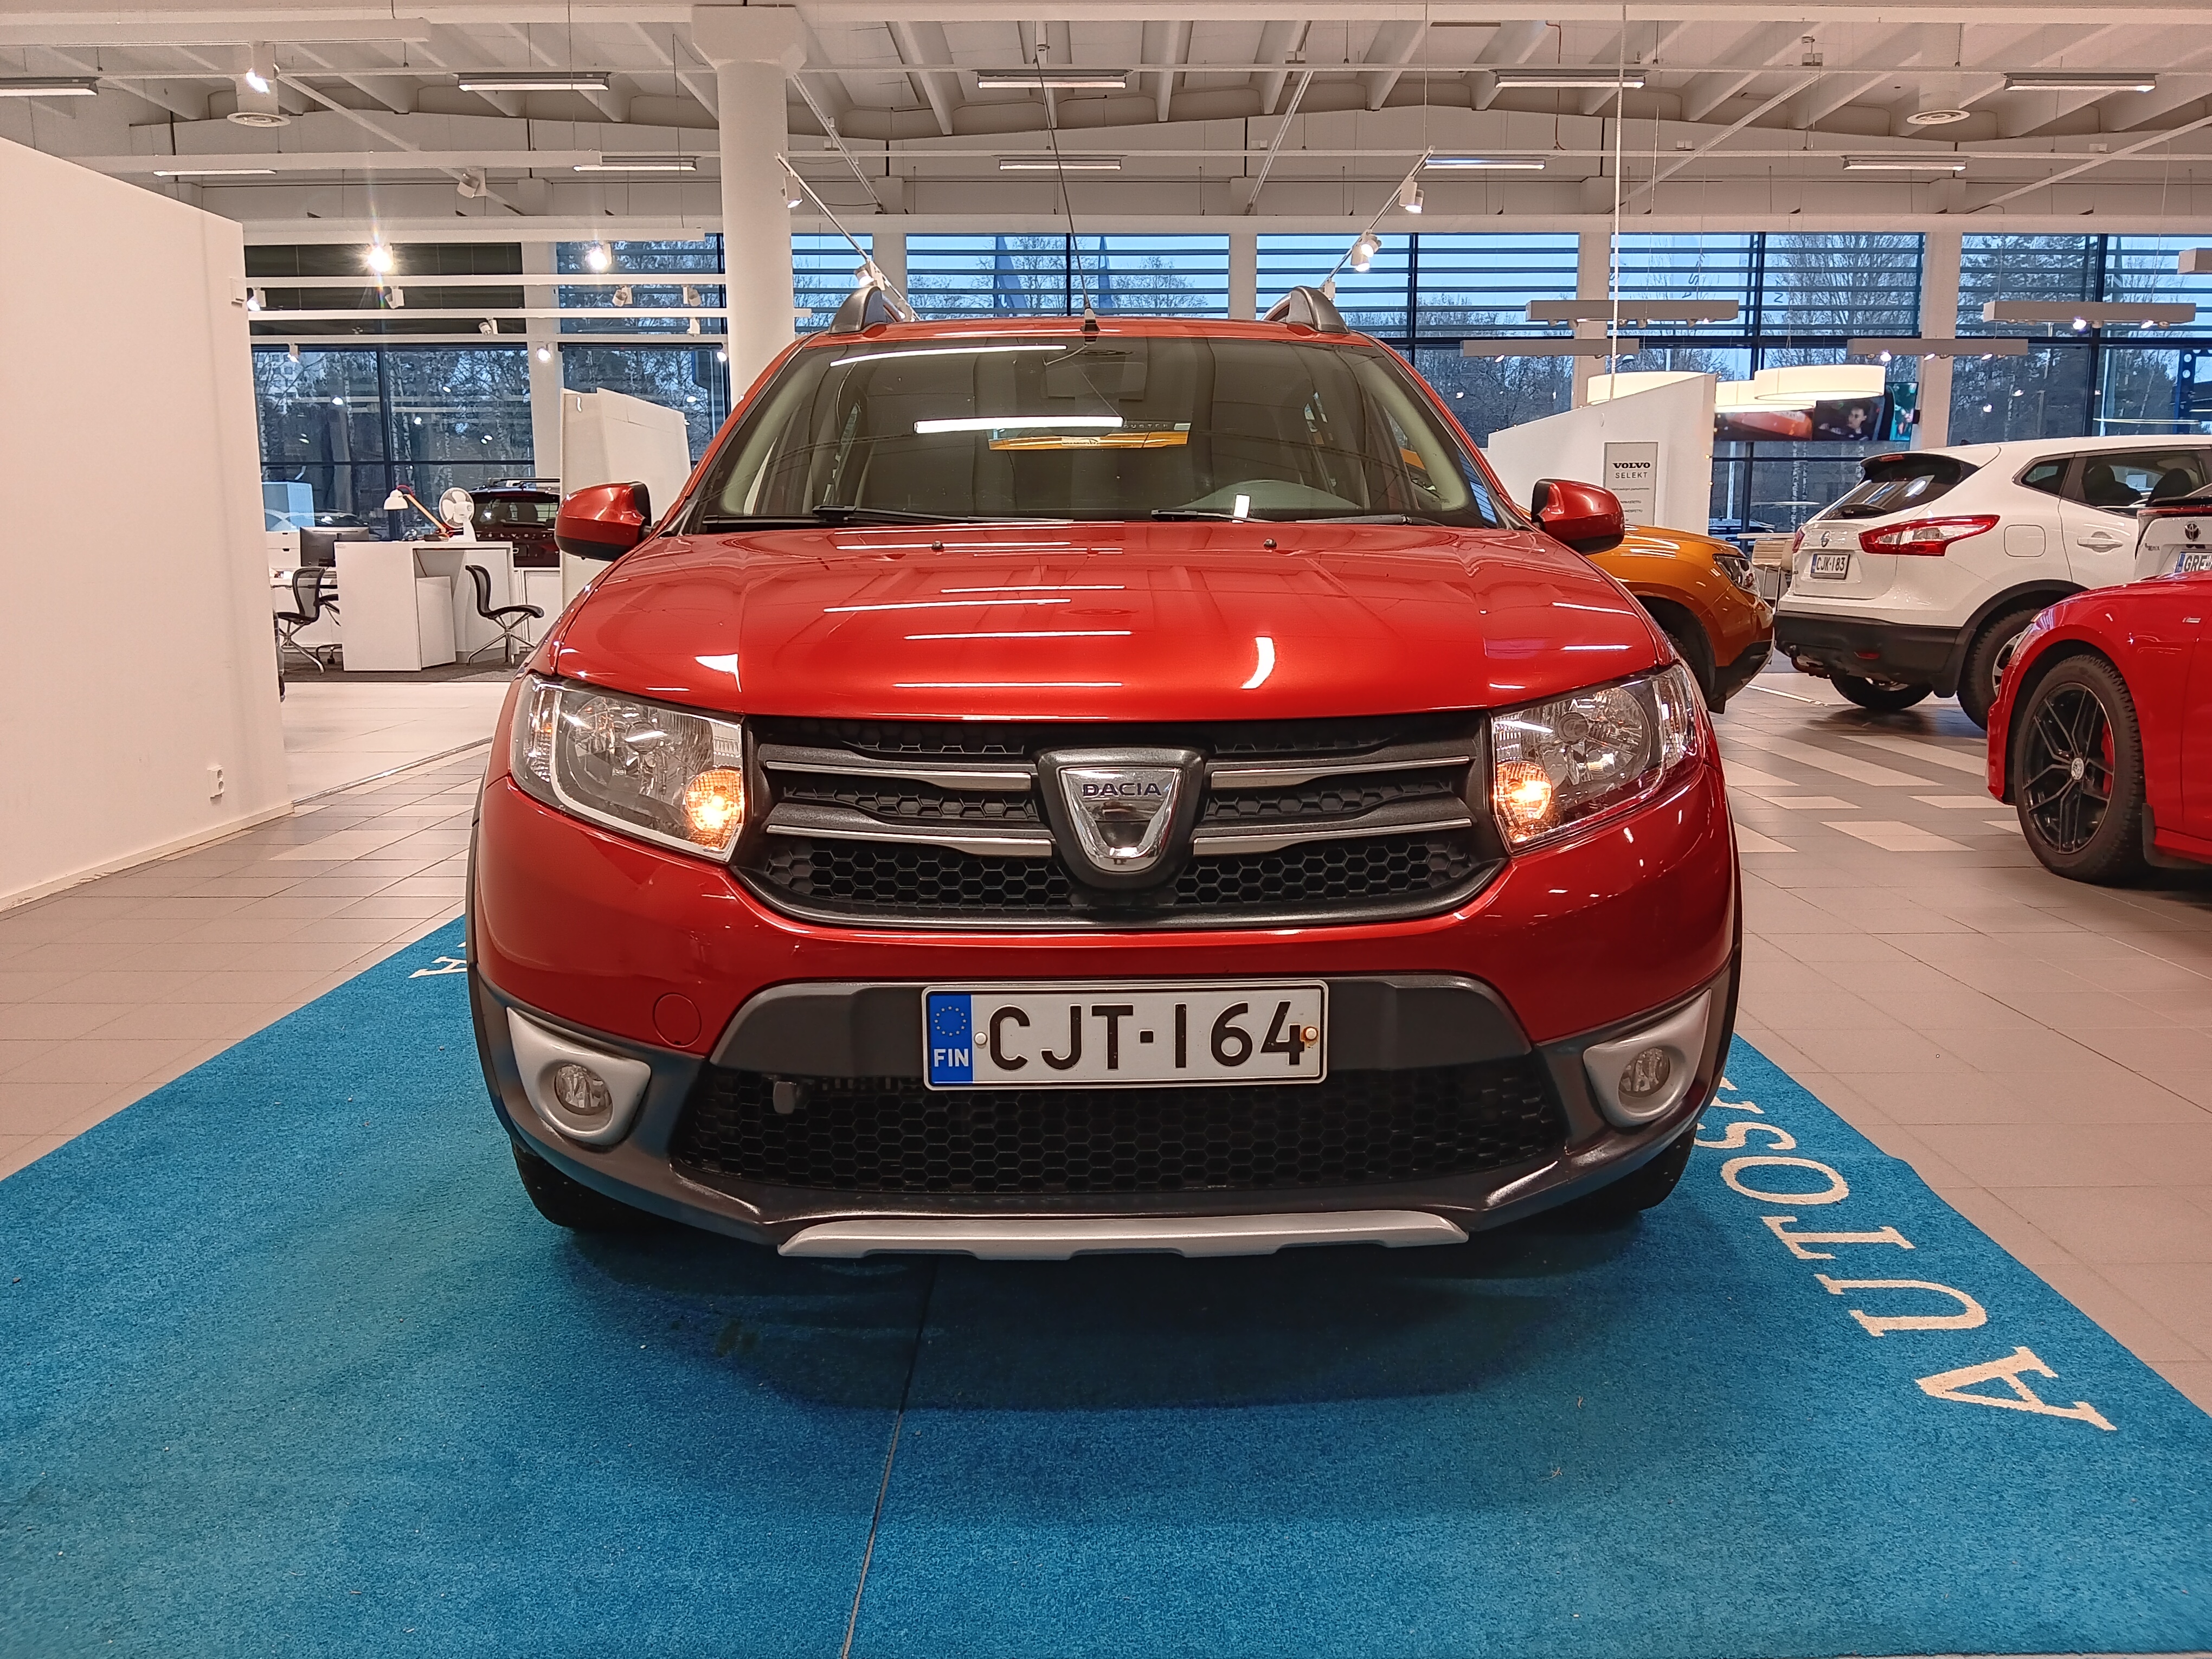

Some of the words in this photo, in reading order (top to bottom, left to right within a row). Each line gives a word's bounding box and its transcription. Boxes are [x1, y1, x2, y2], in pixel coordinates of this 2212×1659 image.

[1083, 782, 1162, 797] DACIA
[988, 1001, 1305, 1071] CJT-164
[934, 1049, 969, 1068] FIN
